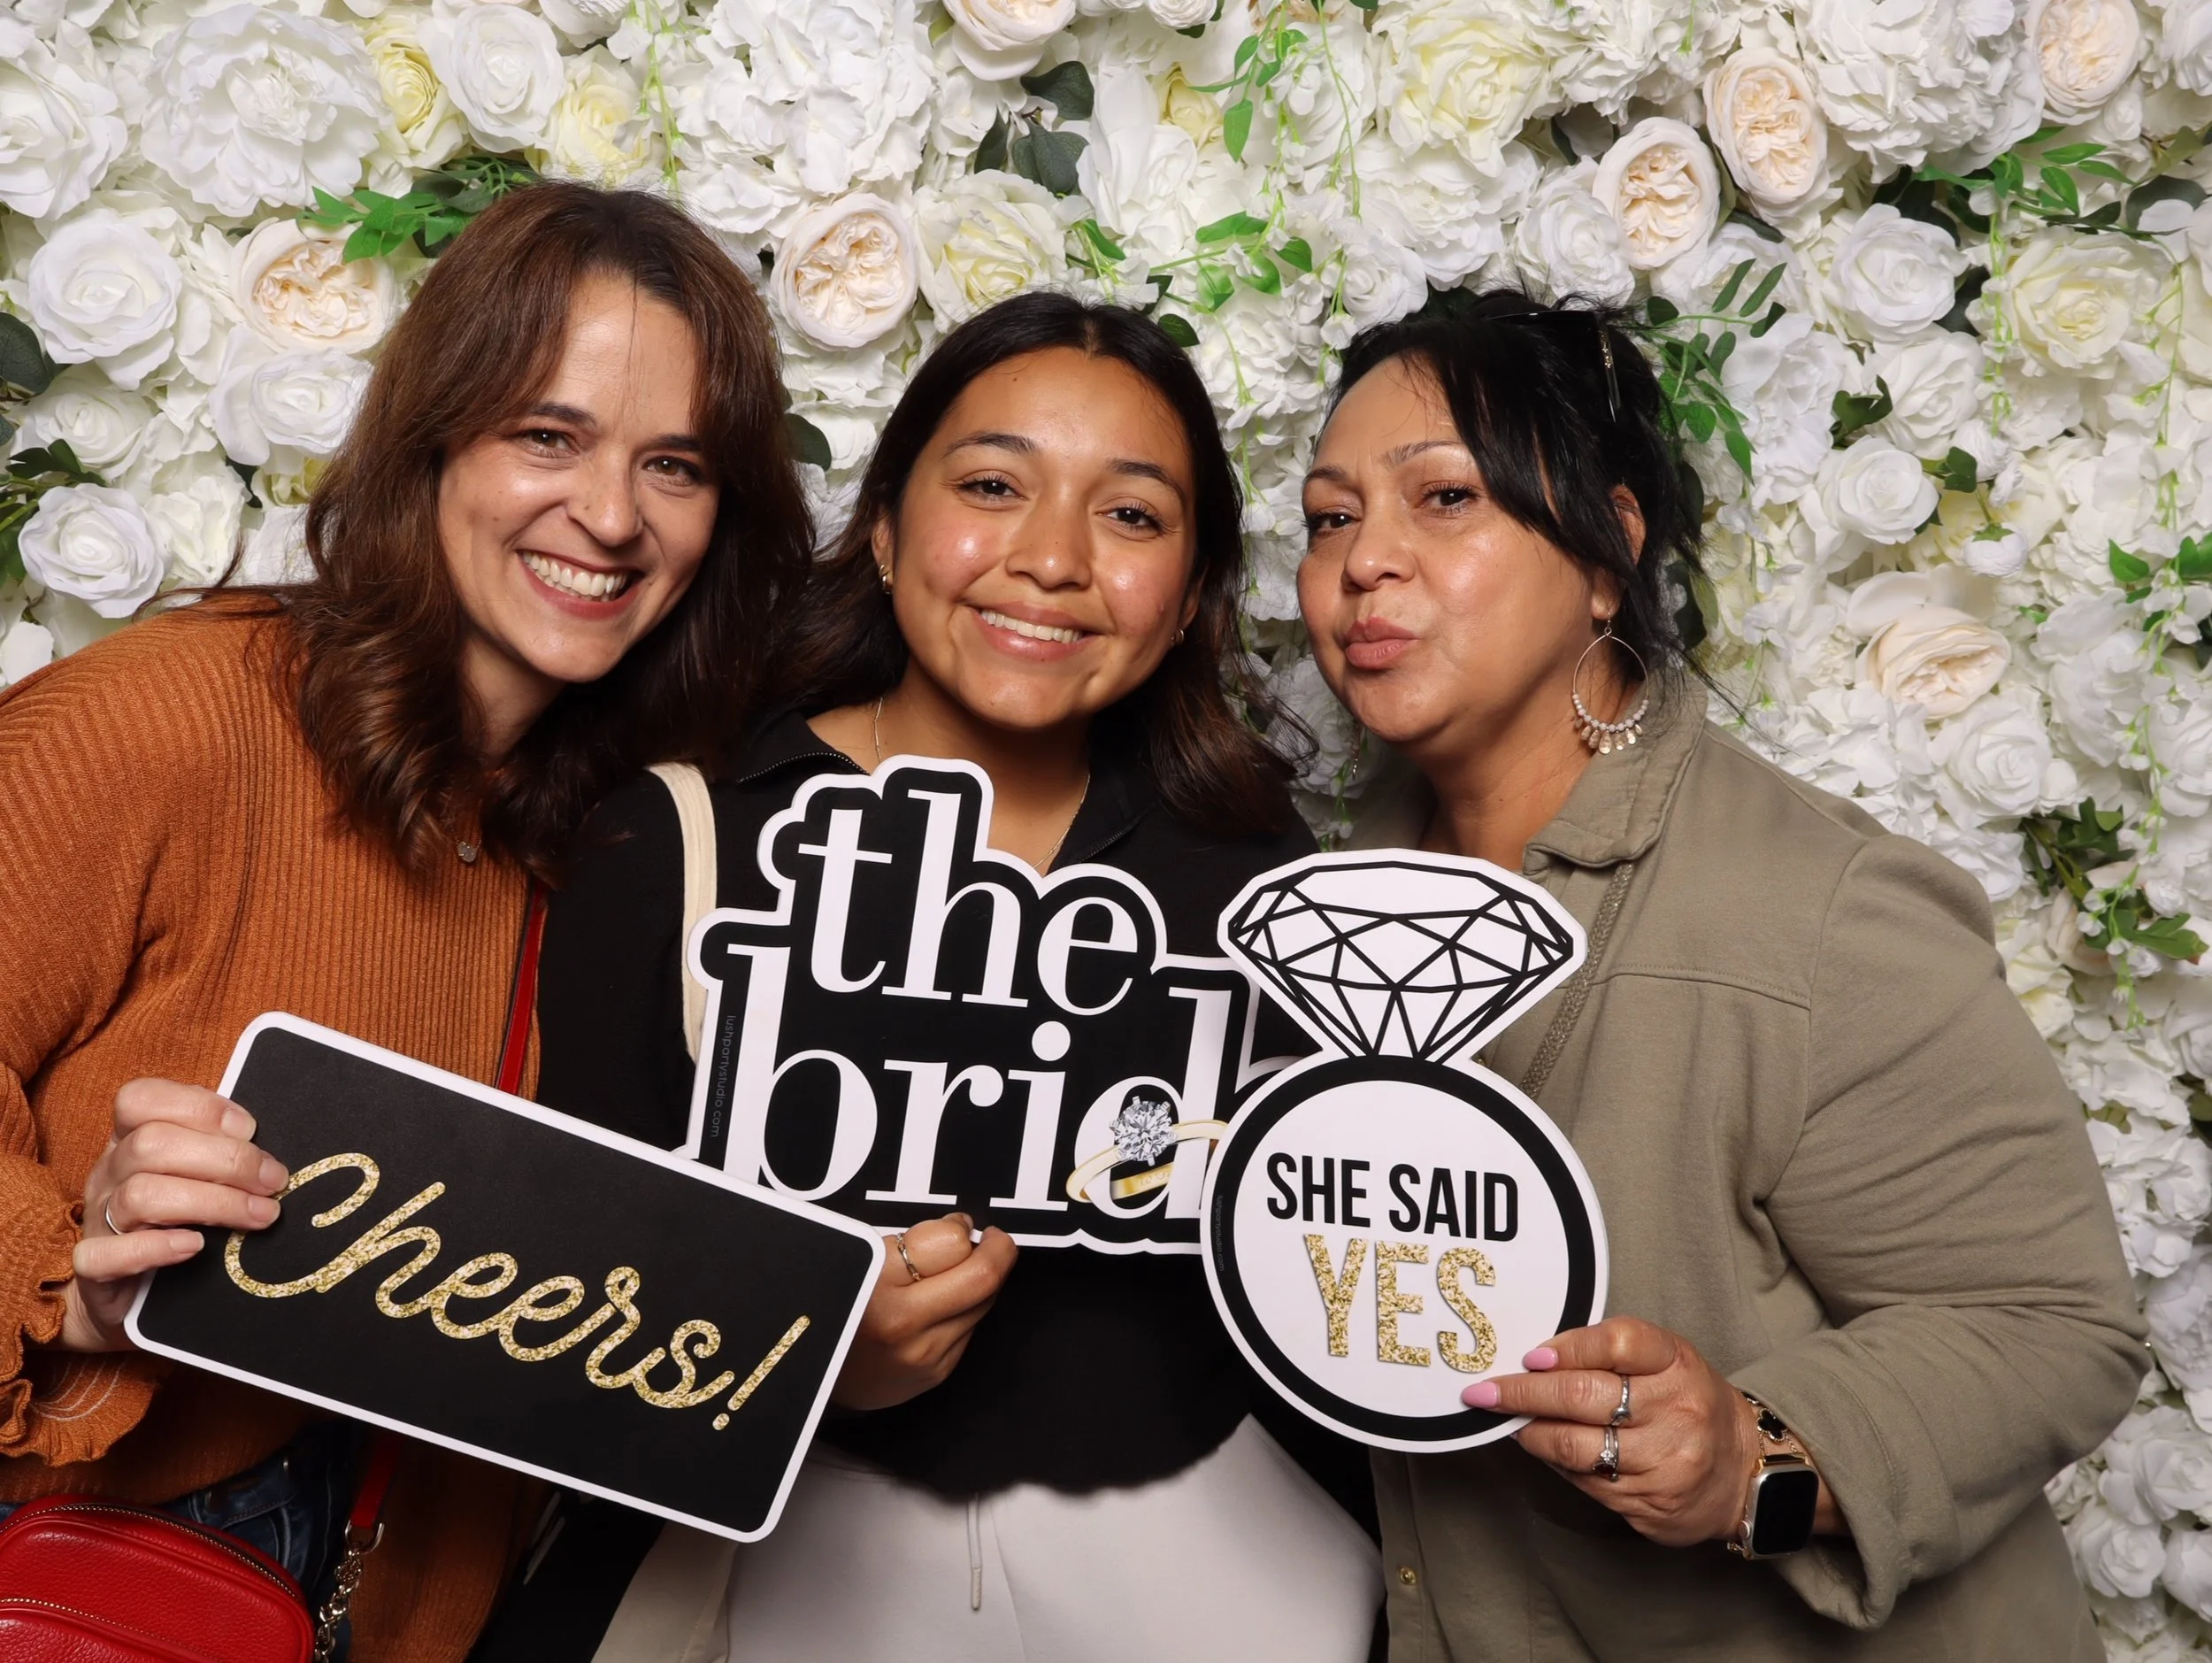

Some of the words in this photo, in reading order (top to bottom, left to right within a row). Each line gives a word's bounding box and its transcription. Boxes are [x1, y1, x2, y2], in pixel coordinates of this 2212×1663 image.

[798, 789, 1138, 1016] the
[710, 1015, 736, 1137] lushpartystudio.com
[726, 943, 1232, 1219] brid
[1266, 1152, 1371, 1228] SHE
[1388, 1164, 1519, 1242] SAID
[224, 1152, 810, 1431] Cheers!
[1303, 1233, 1498, 1374] YES
